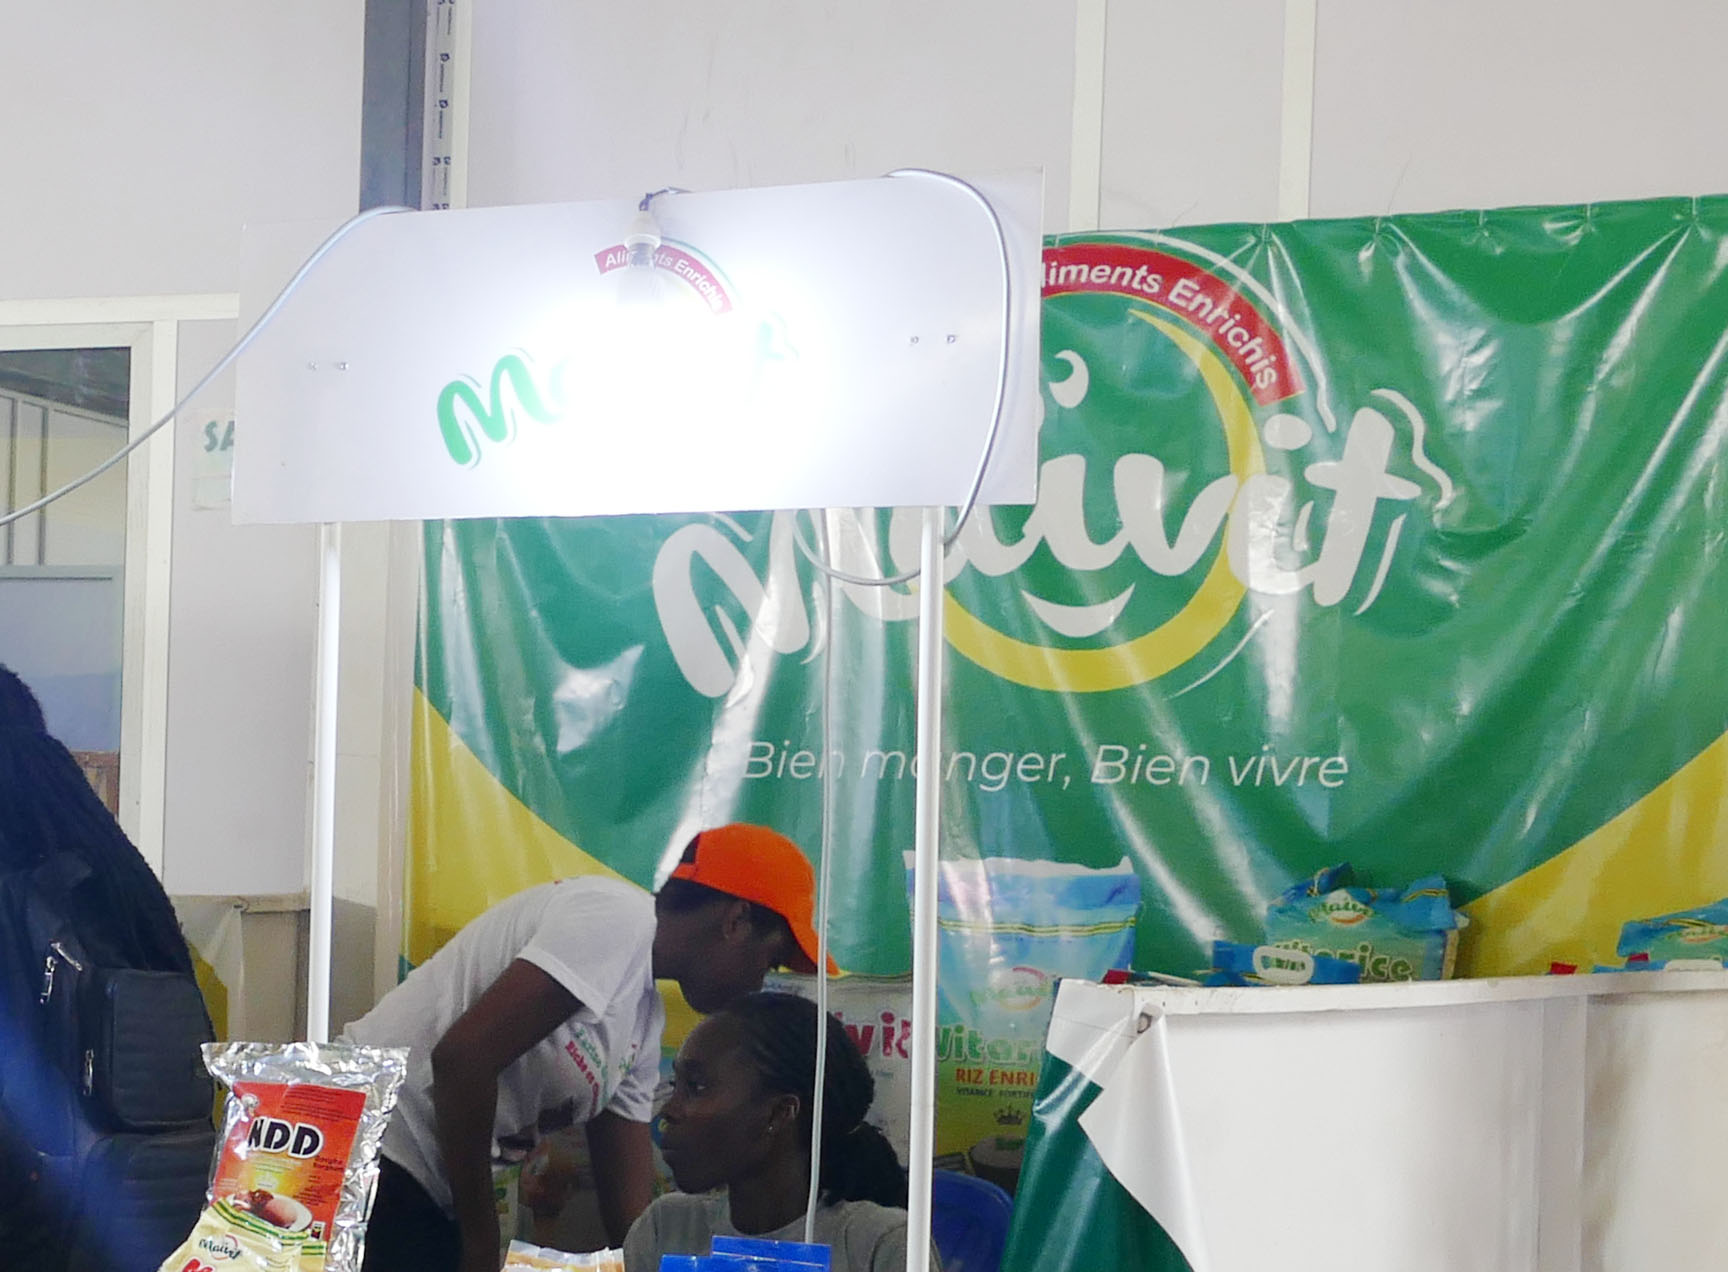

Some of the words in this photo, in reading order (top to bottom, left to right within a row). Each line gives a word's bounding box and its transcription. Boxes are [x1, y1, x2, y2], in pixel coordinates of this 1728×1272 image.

[1169, 278, 1277, 390] Enrichis
[741, 741, 844, 780] Bien
[1091, 744, 1210, 787] Bien
[1229, 745, 1349, 789] vivre
[956, 1068, 983, 1084] RIZ
[990, 1069, 1036, 1087] ENRI
